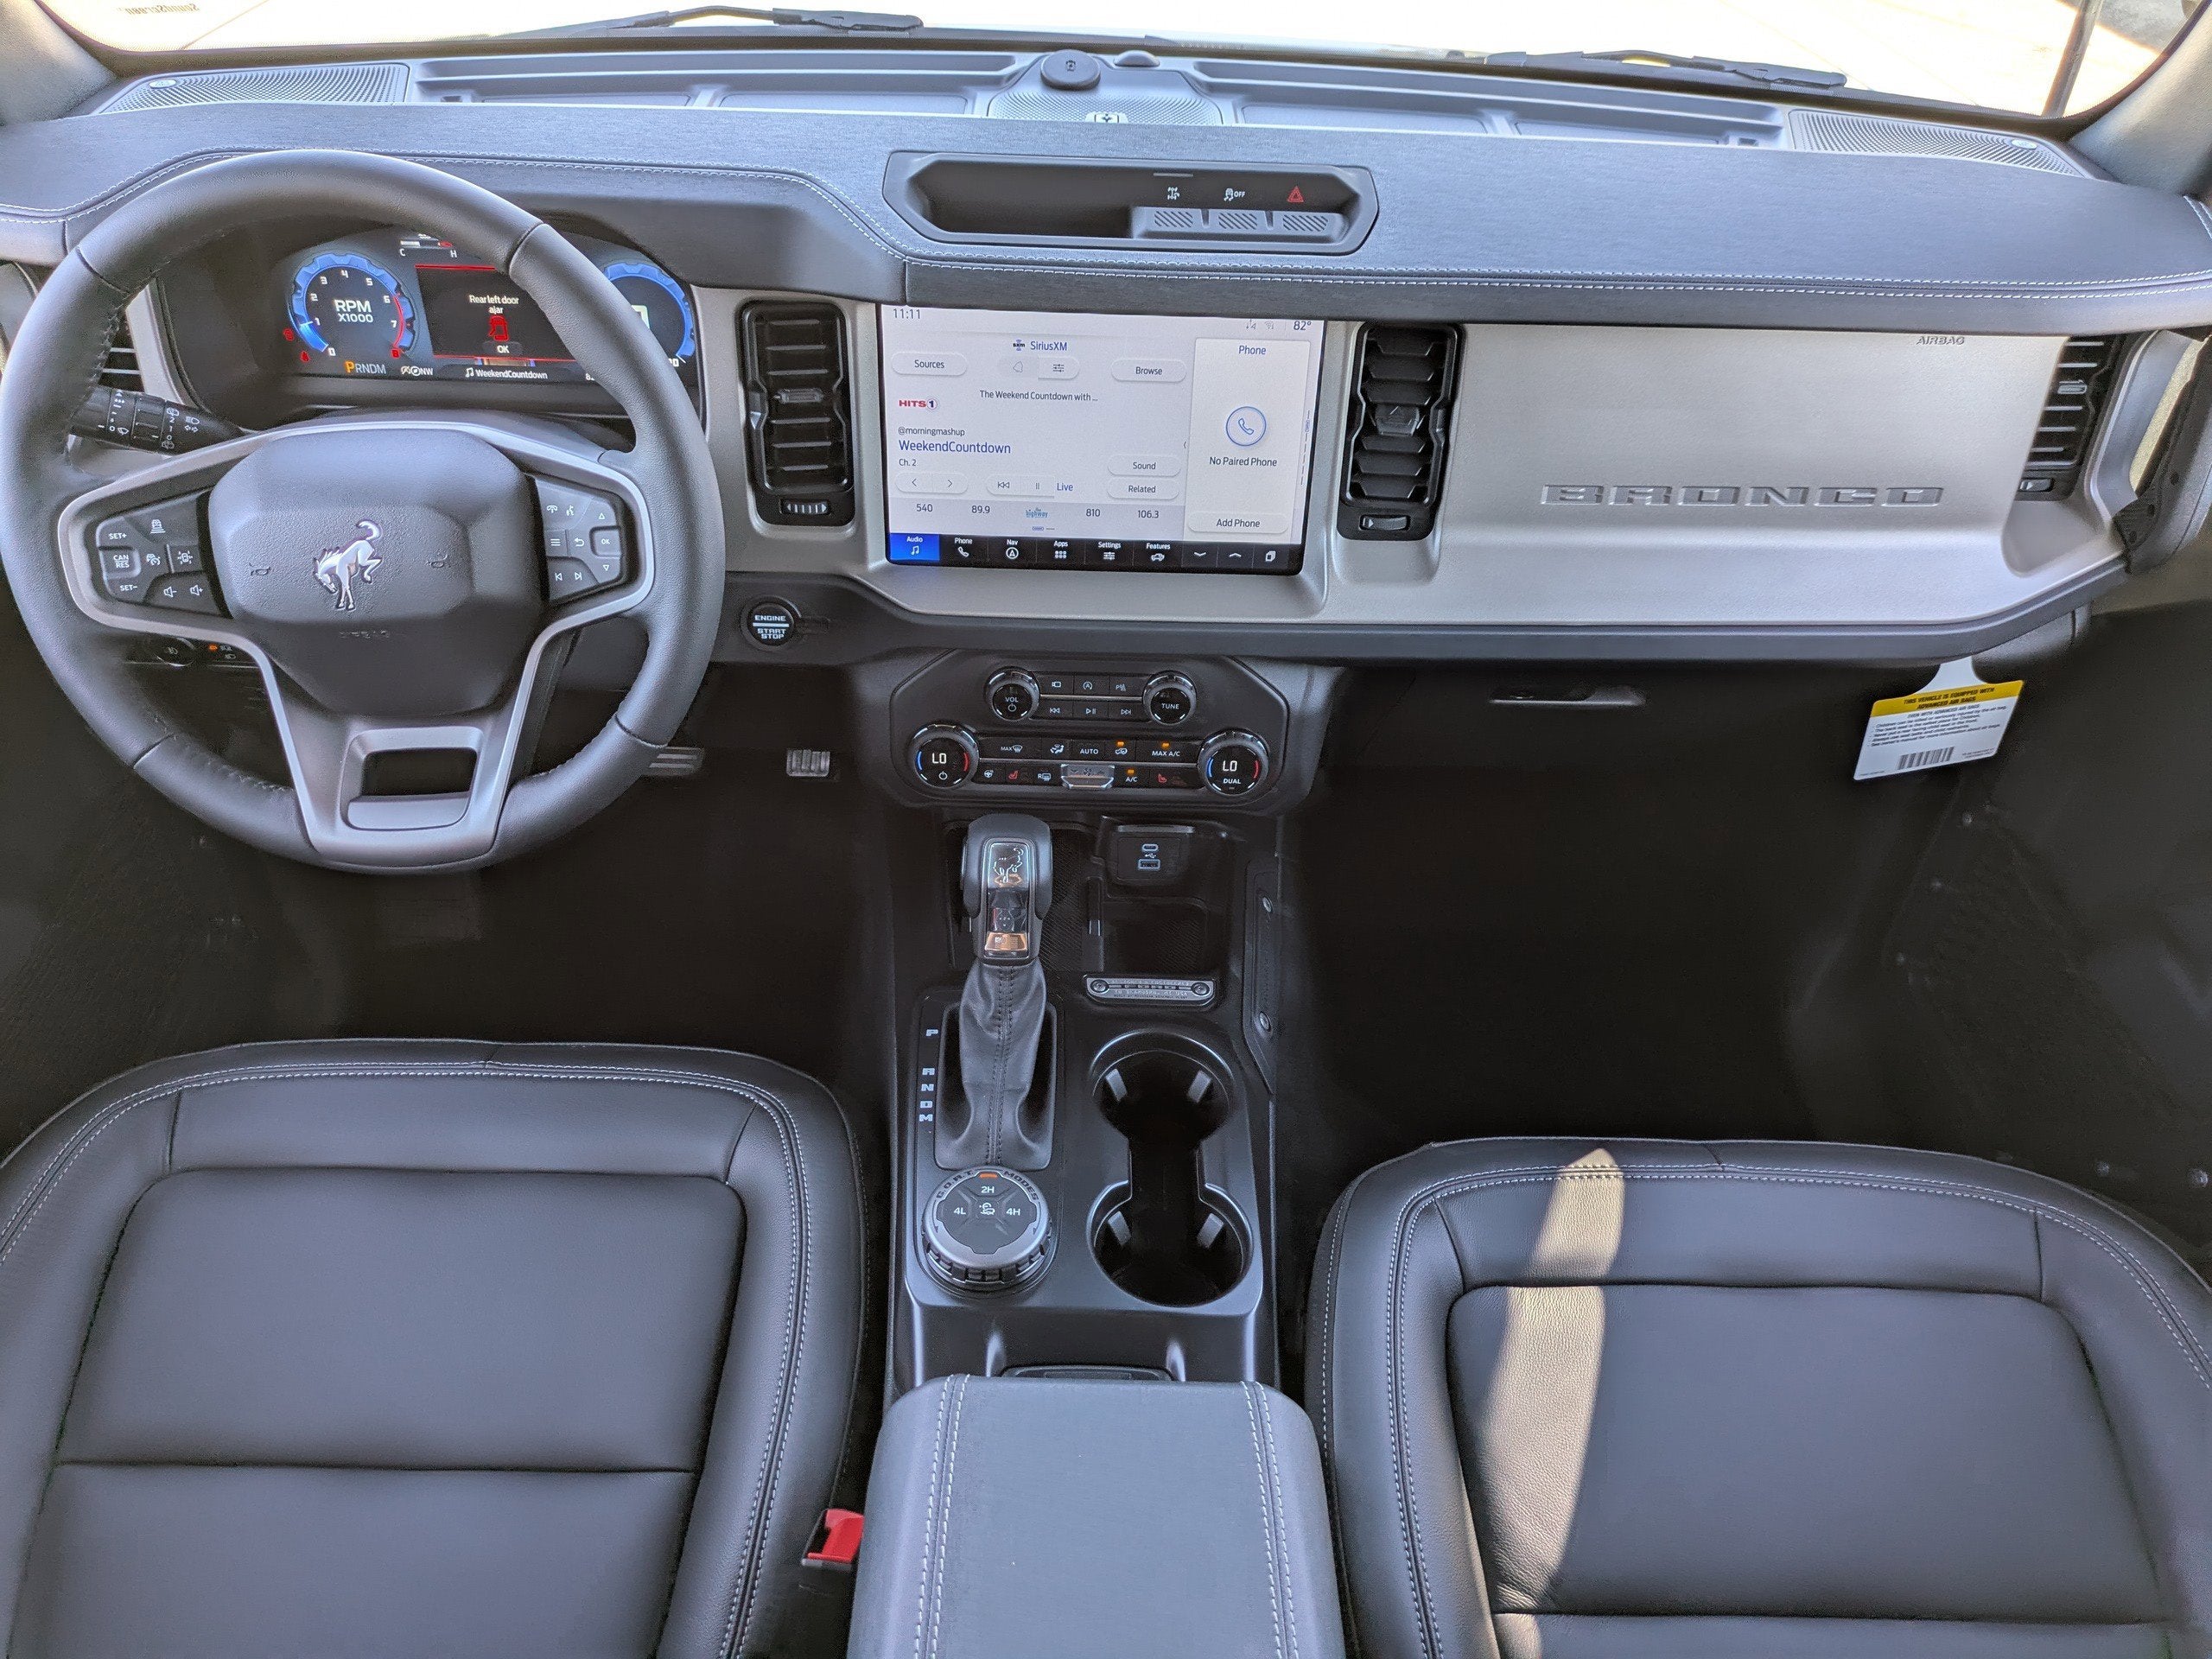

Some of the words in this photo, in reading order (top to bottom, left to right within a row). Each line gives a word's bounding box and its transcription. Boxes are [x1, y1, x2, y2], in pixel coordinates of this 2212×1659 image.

[450, 250, 458, 258] H
[341, 270, 349, 278] 4
[321, 276, 327, 285] 3
[365, 277, 373, 286] 5
[310, 293, 318, 302] 2
[469, 295, 486, 304] Rear
[487, 296, 501, 304] left
[501, 296, 519, 305] door
[334, 299, 372, 313] RPM
[338, 313, 373, 322] X1000
[893, 308, 921, 320] 11:11
[315, 317, 321, 326] 1
[391, 320, 397, 328] 7
[1293, 321, 1312, 331] 82°
[1916, 335, 1966, 346] AIRBAG
[497, 346, 510, 354] OK
[1030, 341, 1068, 351] SiriusXM
[1238, 346, 1268, 355] Phone
[327, 347, 336, 357] 0
[914, 359, 945, 369] Sources
[475, 368, 548, 379] WeekendCountdown
[1135, 366, 1163, 376] Browse
[980, 391, 995, 399] The
[995, 391, 1029, 400] Weekend
[1030, 392, 1072, 401] Countdown
[1073, 393, 1091, 402] with
[898, 427, 965, 436] @morningmashup
[899, 440, 1011, 454] WeekendCountdown
[1132, 461, 1156, 470] Sound
[1209, 457, 1221, 466] No
[1223, 457, 1249, 466] Paired
[1250, 458, 1278, 467] Phone
[1540, 484, 1945, 508] BRONCO
[916, 504, 933, 512] 540
[971, 505, 990, 514] 89.9
[1085, 508, 1101, 517] 810
[1137, 510, 1160, 518] 106.3
[1235, 519, 1261, 528] Phone
[925, 1028, 939, 1037] P
[920, 1100, 933, 1109] D
[918, 1114, 933, 1122] M
[1003, 1171, 1039, 1201] MODES
